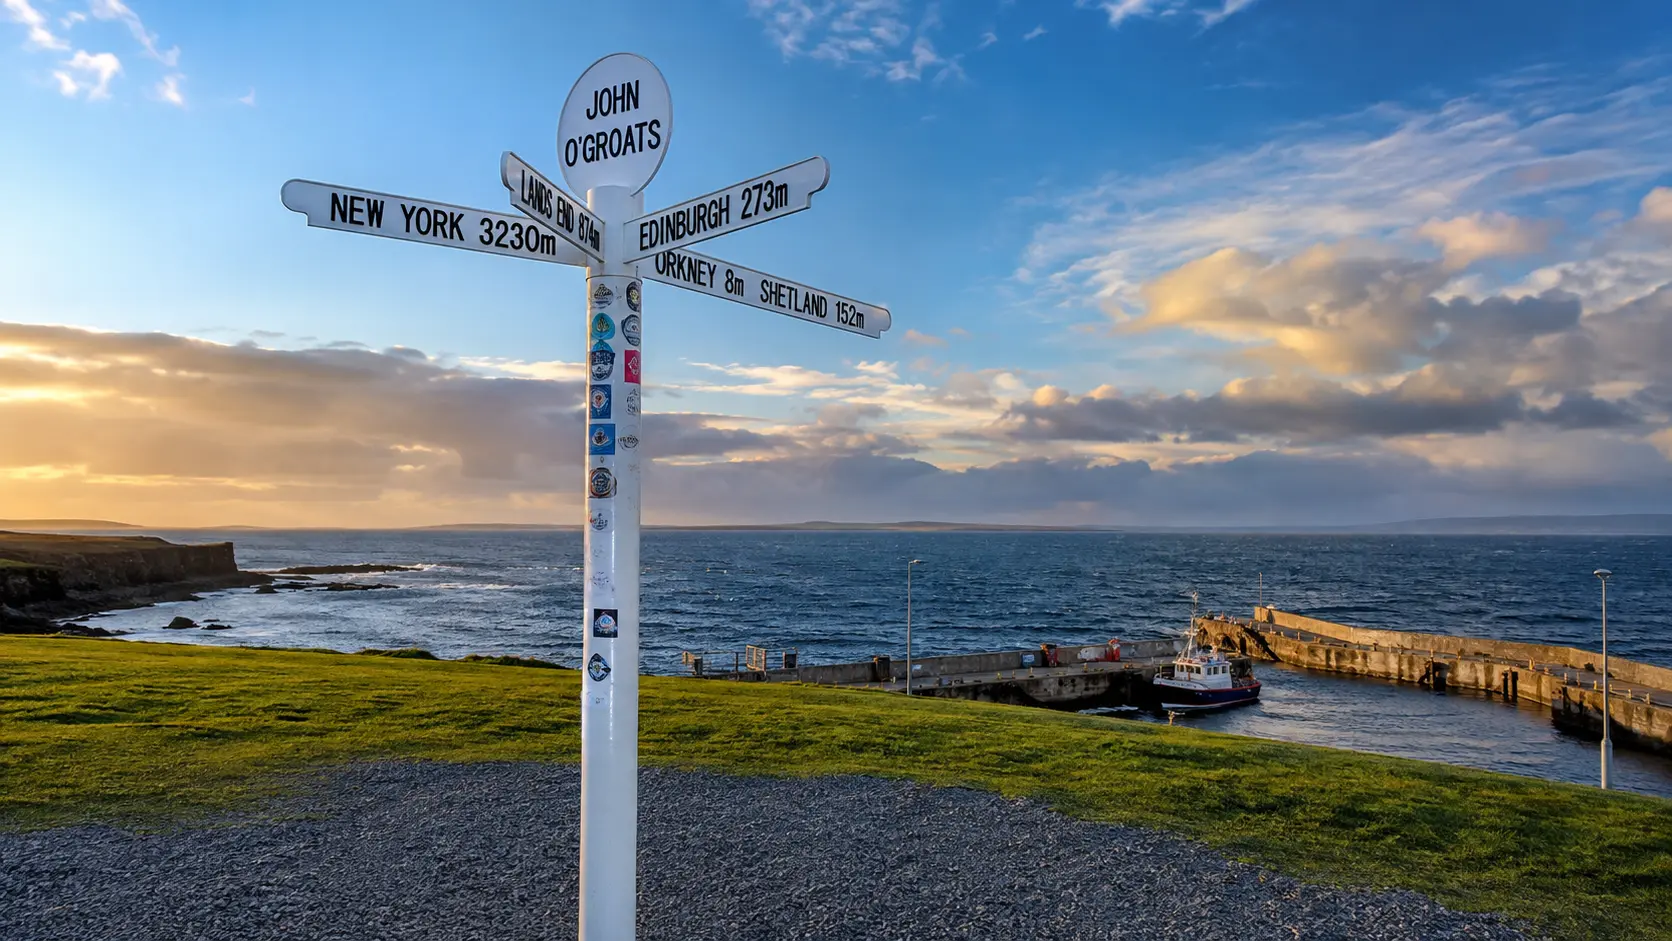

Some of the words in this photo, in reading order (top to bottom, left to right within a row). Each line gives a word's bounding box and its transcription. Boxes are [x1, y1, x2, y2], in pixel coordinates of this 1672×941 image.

[586, 80, 640, 120] JOHN
[565, 119, 661, 167] O'GROATS
[330, 192, 384, 228] NEW
[400, 203, 465, 241] YORK
[479, 217, 556, 256] 3230m
[520, 169, 553, 219] LANDS
[556, 196, 575, 234] END
[578, 212, 600, 252] 874m
[639, 194, 730, 252] EDINBURGH
[741, 180, 789, 220] 273m
[655, 250, 717, 289] ORKNEY
[725, 269, 744, 297] 8m
[760, 279, 828, 318] SHETLAND
[836, 301, 865, 329] 152m
